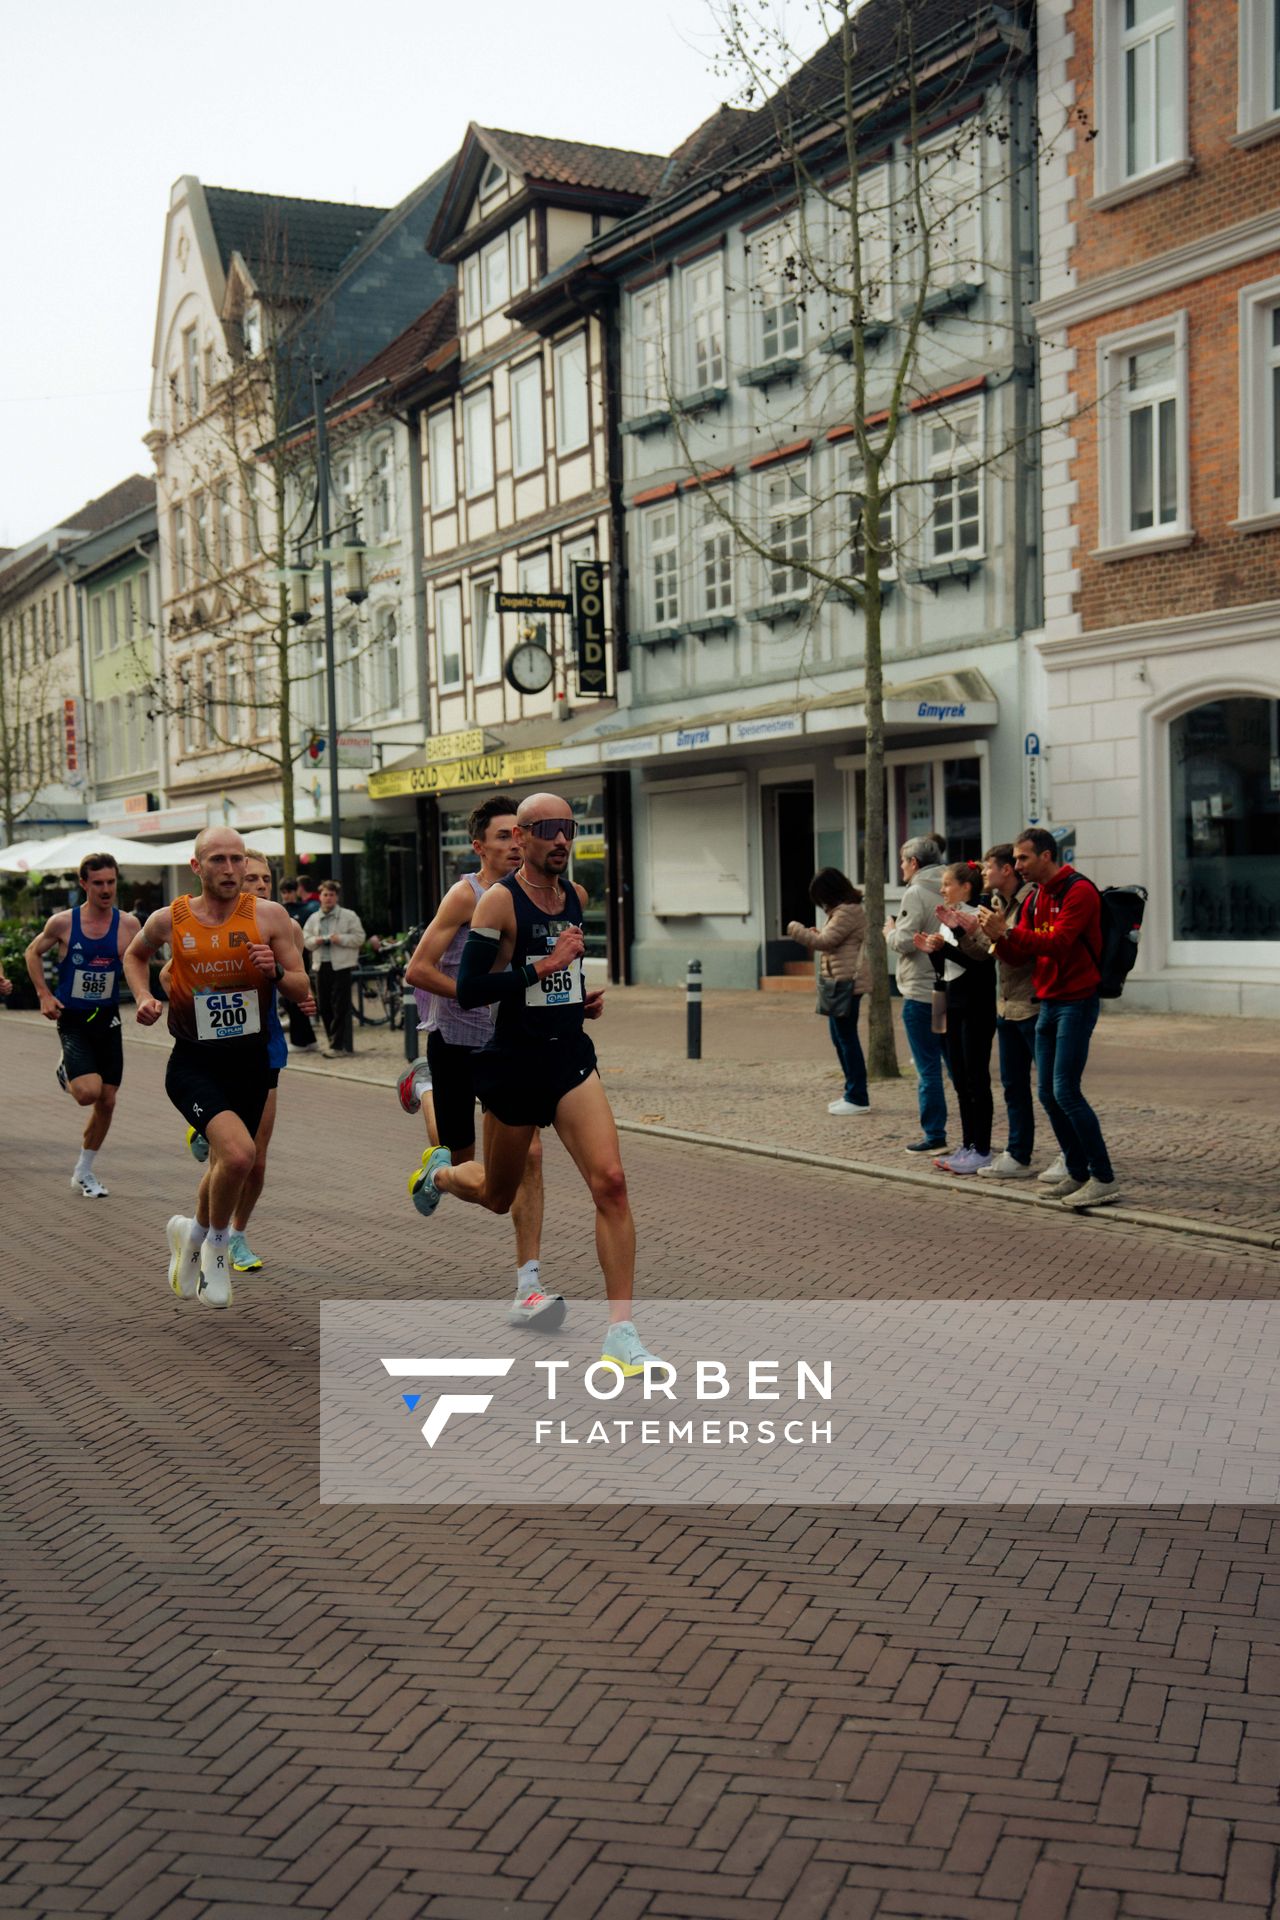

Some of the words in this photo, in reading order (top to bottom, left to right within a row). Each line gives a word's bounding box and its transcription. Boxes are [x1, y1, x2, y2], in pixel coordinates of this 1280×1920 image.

[580, 569, 603, 664] GOLD
[917, 702, 965, 720] Gmyrek
[677, 729, 709, 750] Gmyrek
[410, 768, 438, 789] GOLD
[458, 757, 504, 783] ANKAUF
[191, 959, 244, 974] VIACTIV
[82, 972, 107, 982] GLS
[541, 971, 572, 993] 656
[82, 981, 106, 993] 985
[206, 993, 243, 1010] GLS
[209, 1007, 247, 1028] 200
